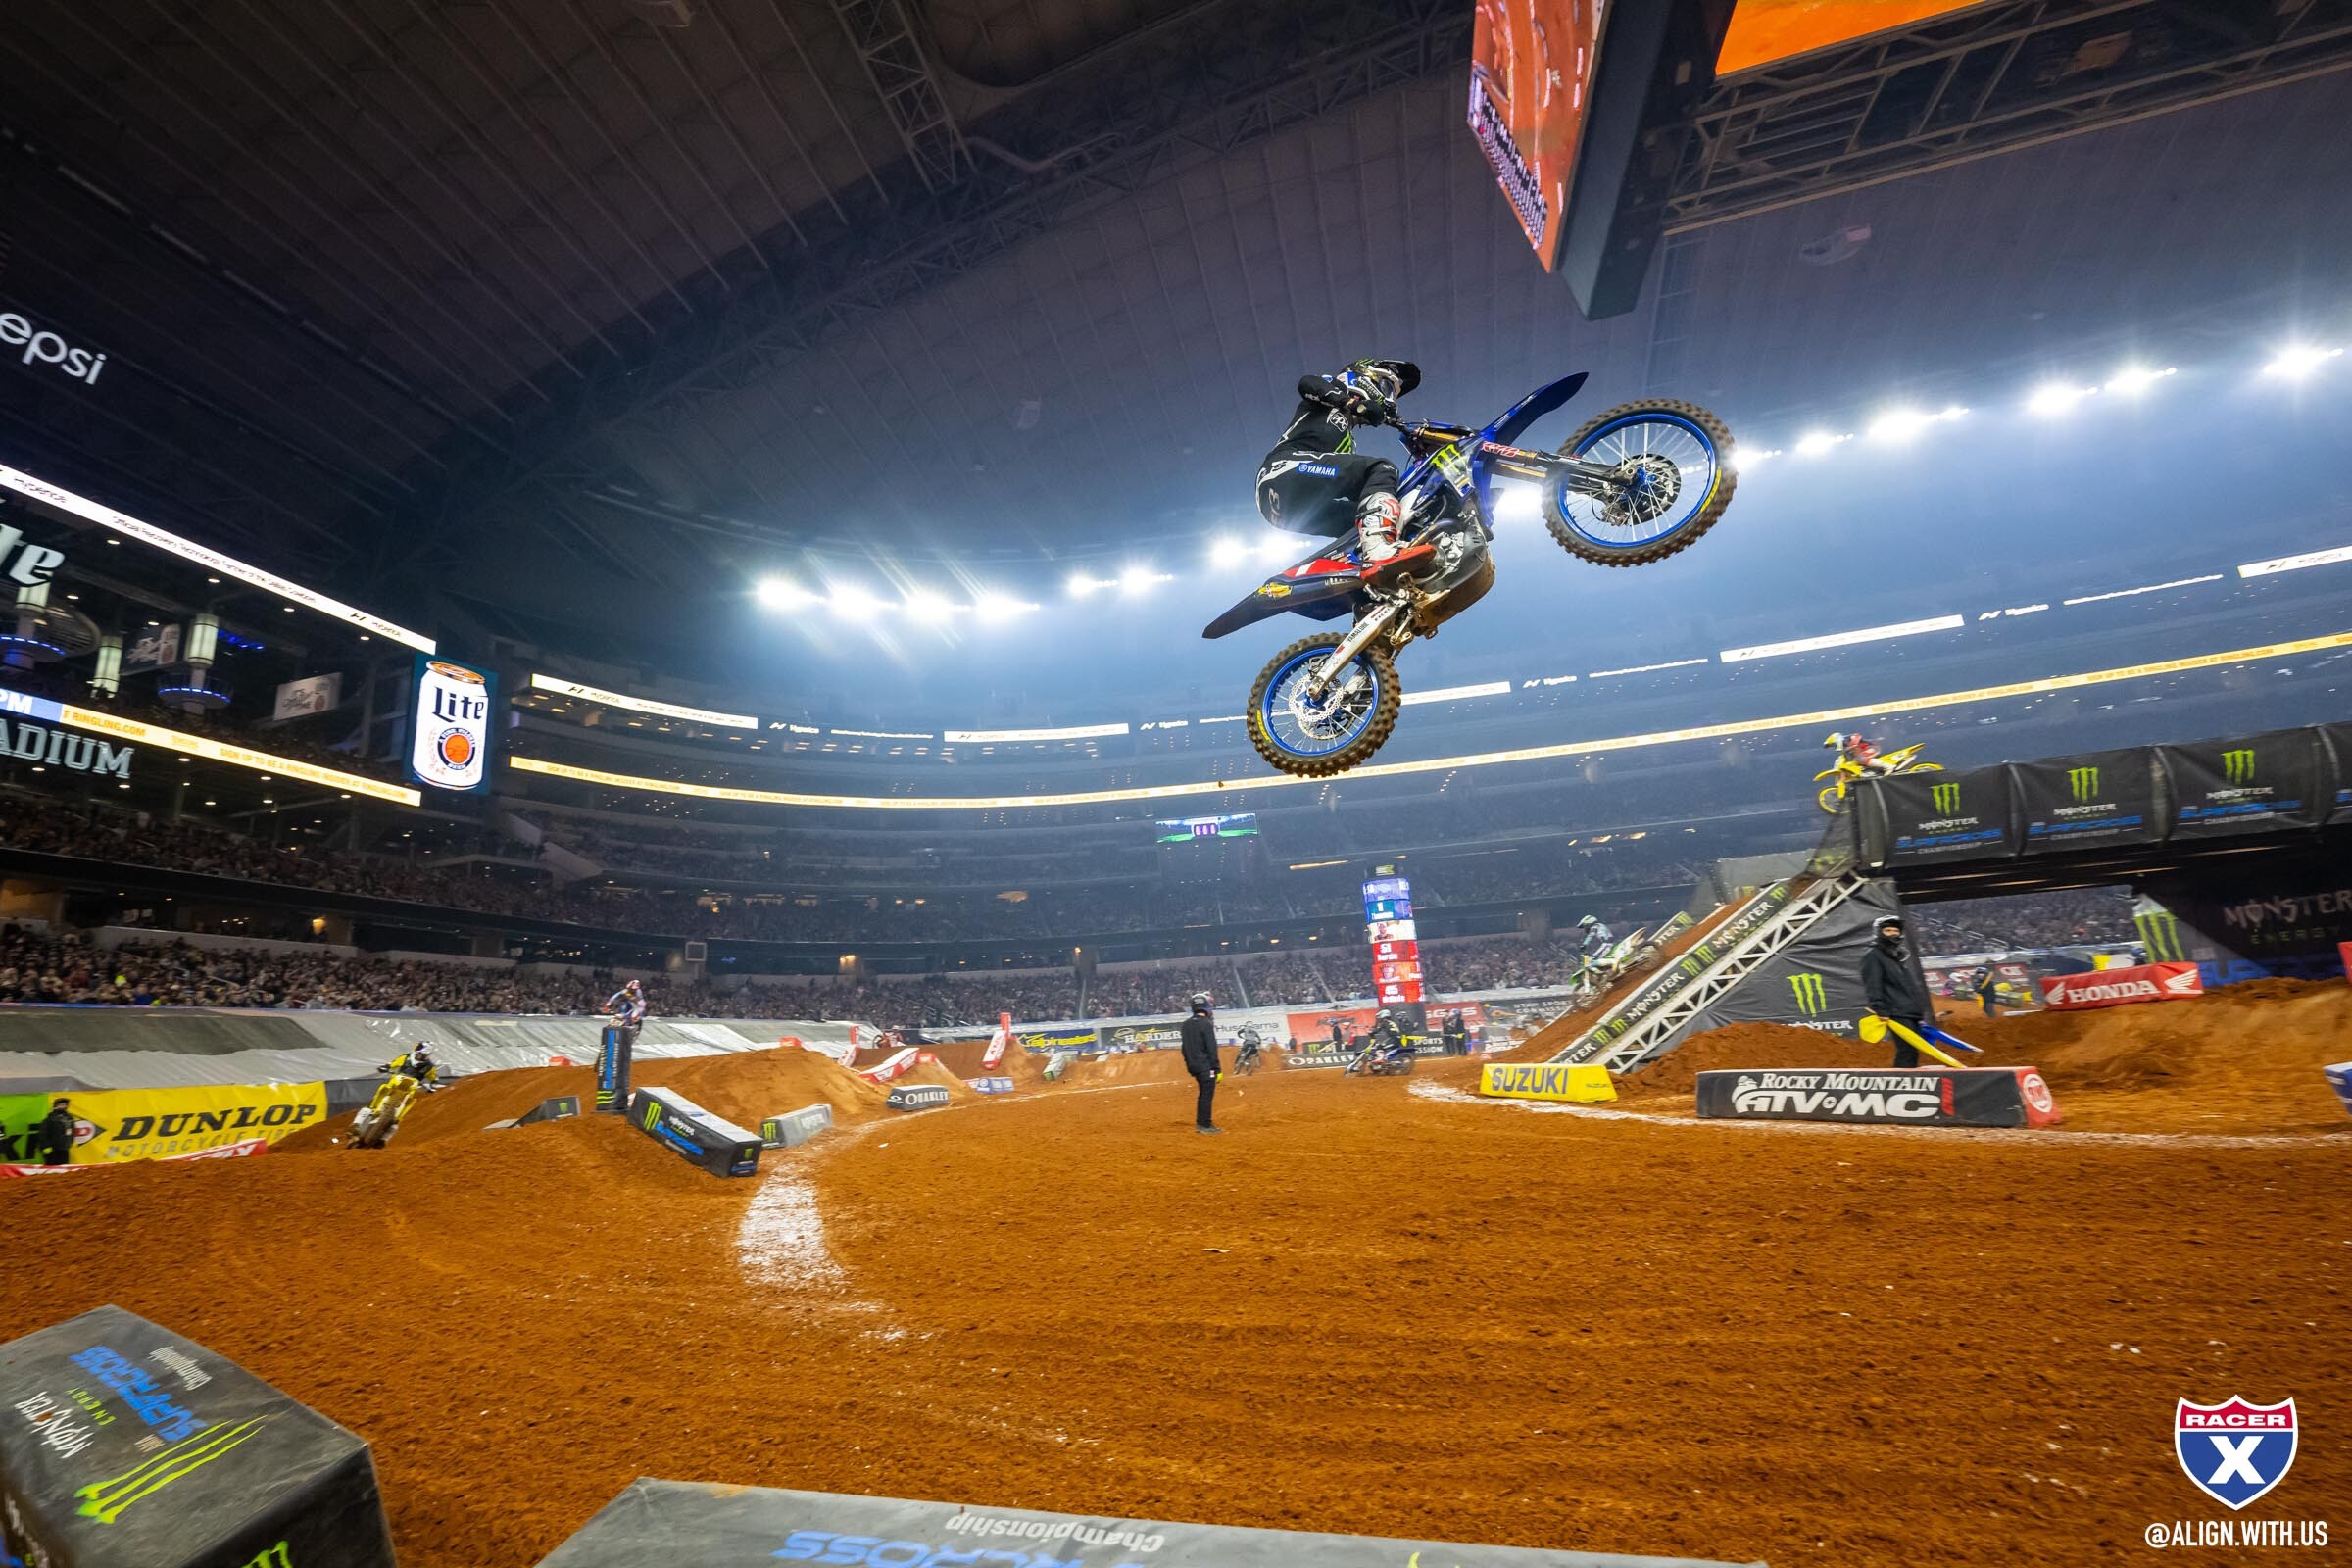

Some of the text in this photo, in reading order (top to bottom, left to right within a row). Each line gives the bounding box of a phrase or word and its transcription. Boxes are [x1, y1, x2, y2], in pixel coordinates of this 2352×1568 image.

[0, 313, 107, 385] epsi
[1307, 466, 1336, 476] YAMAHA
[432, 686, 484, 723] Lite
[1711, 901, 1775, 949] MONSTER
[2224, 889, 2352, 928] MONSTER
[1626, 972, 1686, 1021] MONSTER
[2066, 980, 2162, 1004] HONDA
[1781, 1020, 1854, 1030] NSTER
[1492, 1067, 1569, 1095] SUZUKI
[1760, 1073, 1939, 1092] ROCKY MOUNTAIN
[111, 1104, 317, 1141] DUNLOP
[65, 1387, 117, 1427] ENERGY
[68, 1345, 209, 1443] SUPERCROSS
[14, 1391, 95, 1460] MONSTER
[944, 1511, 1167, 1554] Championship
